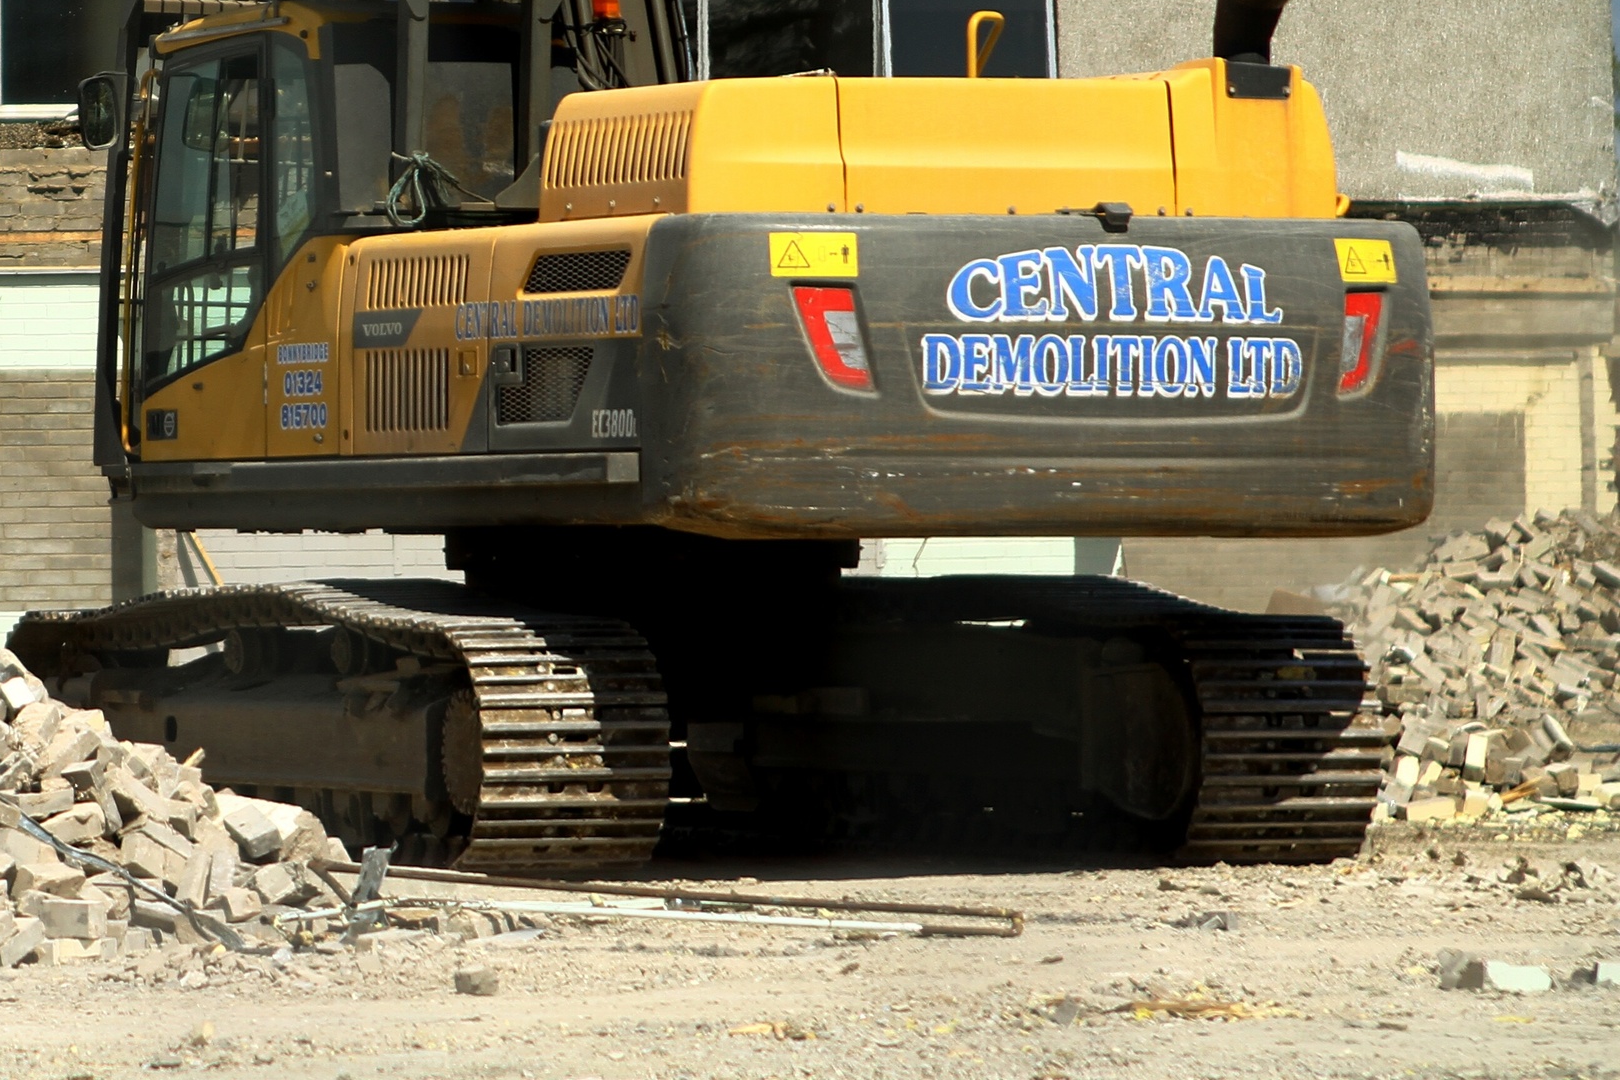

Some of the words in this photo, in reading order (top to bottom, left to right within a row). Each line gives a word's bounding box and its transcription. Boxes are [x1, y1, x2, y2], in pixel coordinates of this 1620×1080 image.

[946, 243, 1284, 324] CENTRAL
[362, 322, 403, 337] VOLVO
[455, 300, 517, 341] CENTRAL
[522, 295, 610, 338] DEMOLITION
[614, 294, 640, 334] LTD
[277, 341, 329, 365] BONNYBRIDGE
[921, 333, 1218, 398] DEMOLITION
[1226, 336, 1302, 400] LTD
[284, 369, 323, 397] 01324
[281, 401, 327, 430] 815700
